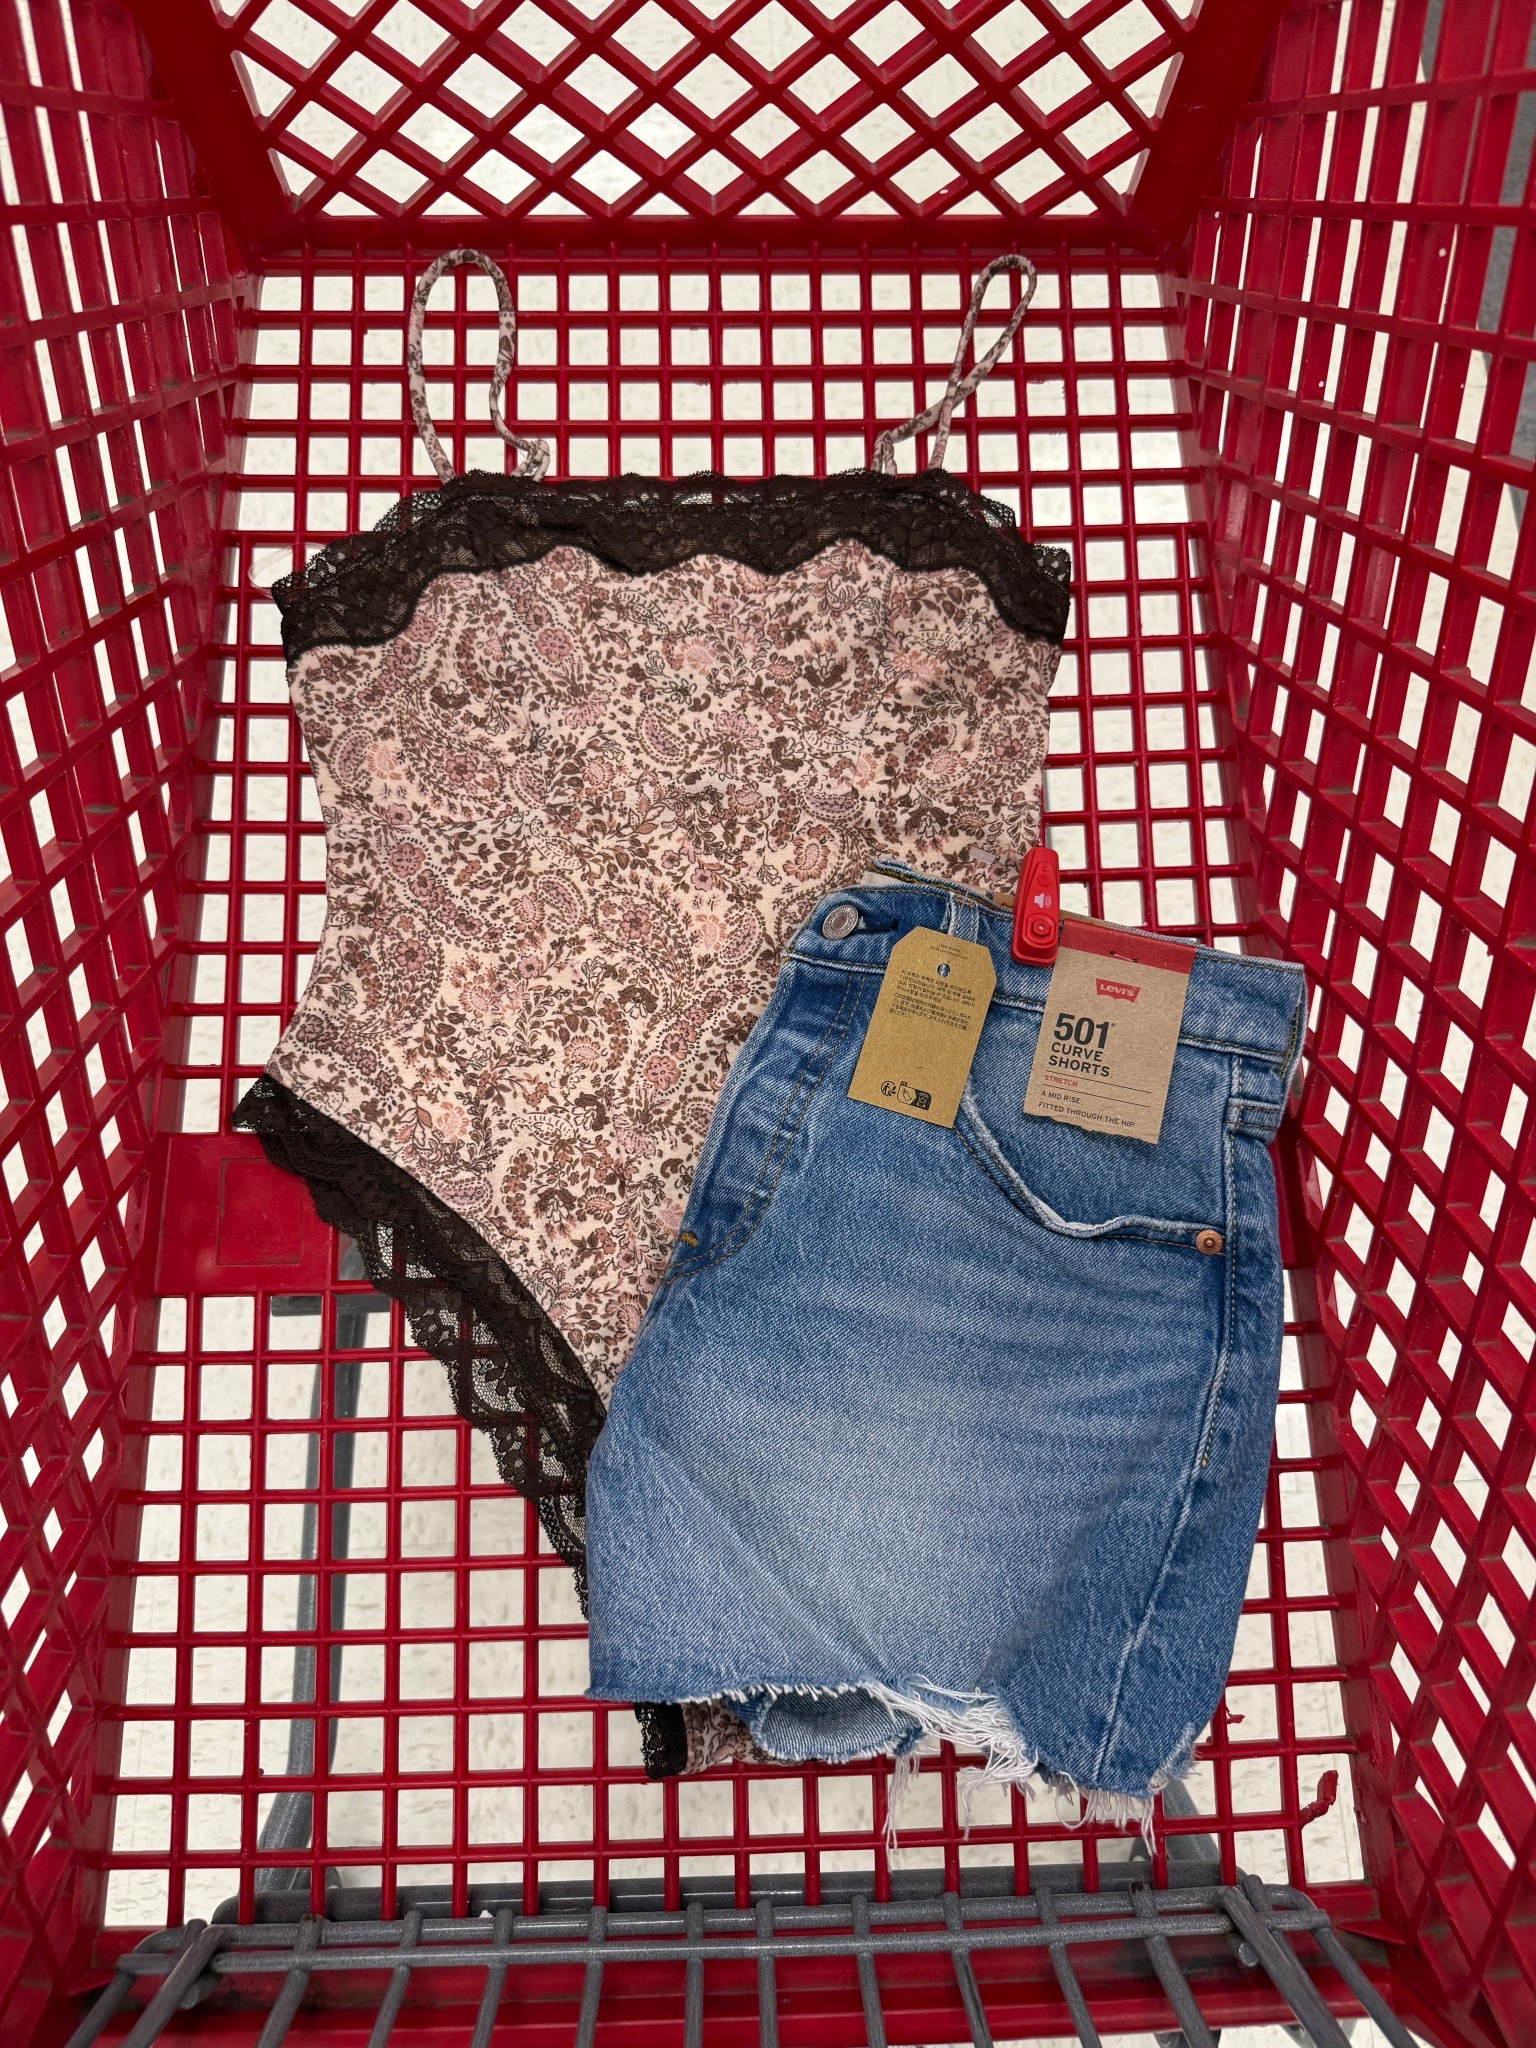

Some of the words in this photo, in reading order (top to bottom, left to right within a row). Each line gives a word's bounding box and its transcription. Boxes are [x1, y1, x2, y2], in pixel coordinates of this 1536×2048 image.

[1051, 1041, 1103, 1062] CURVE
[1048, 1054, 1110, 1077] SHORTS
[1044, 1074, 1078, 1087] STRETCH
[1048, 1091, 1062, 1100] MID
[1063, 1095, 1081, 1104] RISE
[1038, 1101, 1064, 1113] FITTED
[1066, 1107, 1103, 1121] THROUGH
[1104, 1115, 1120, 1125] THE
[1121, 1119, 1135, 1127] HIP
